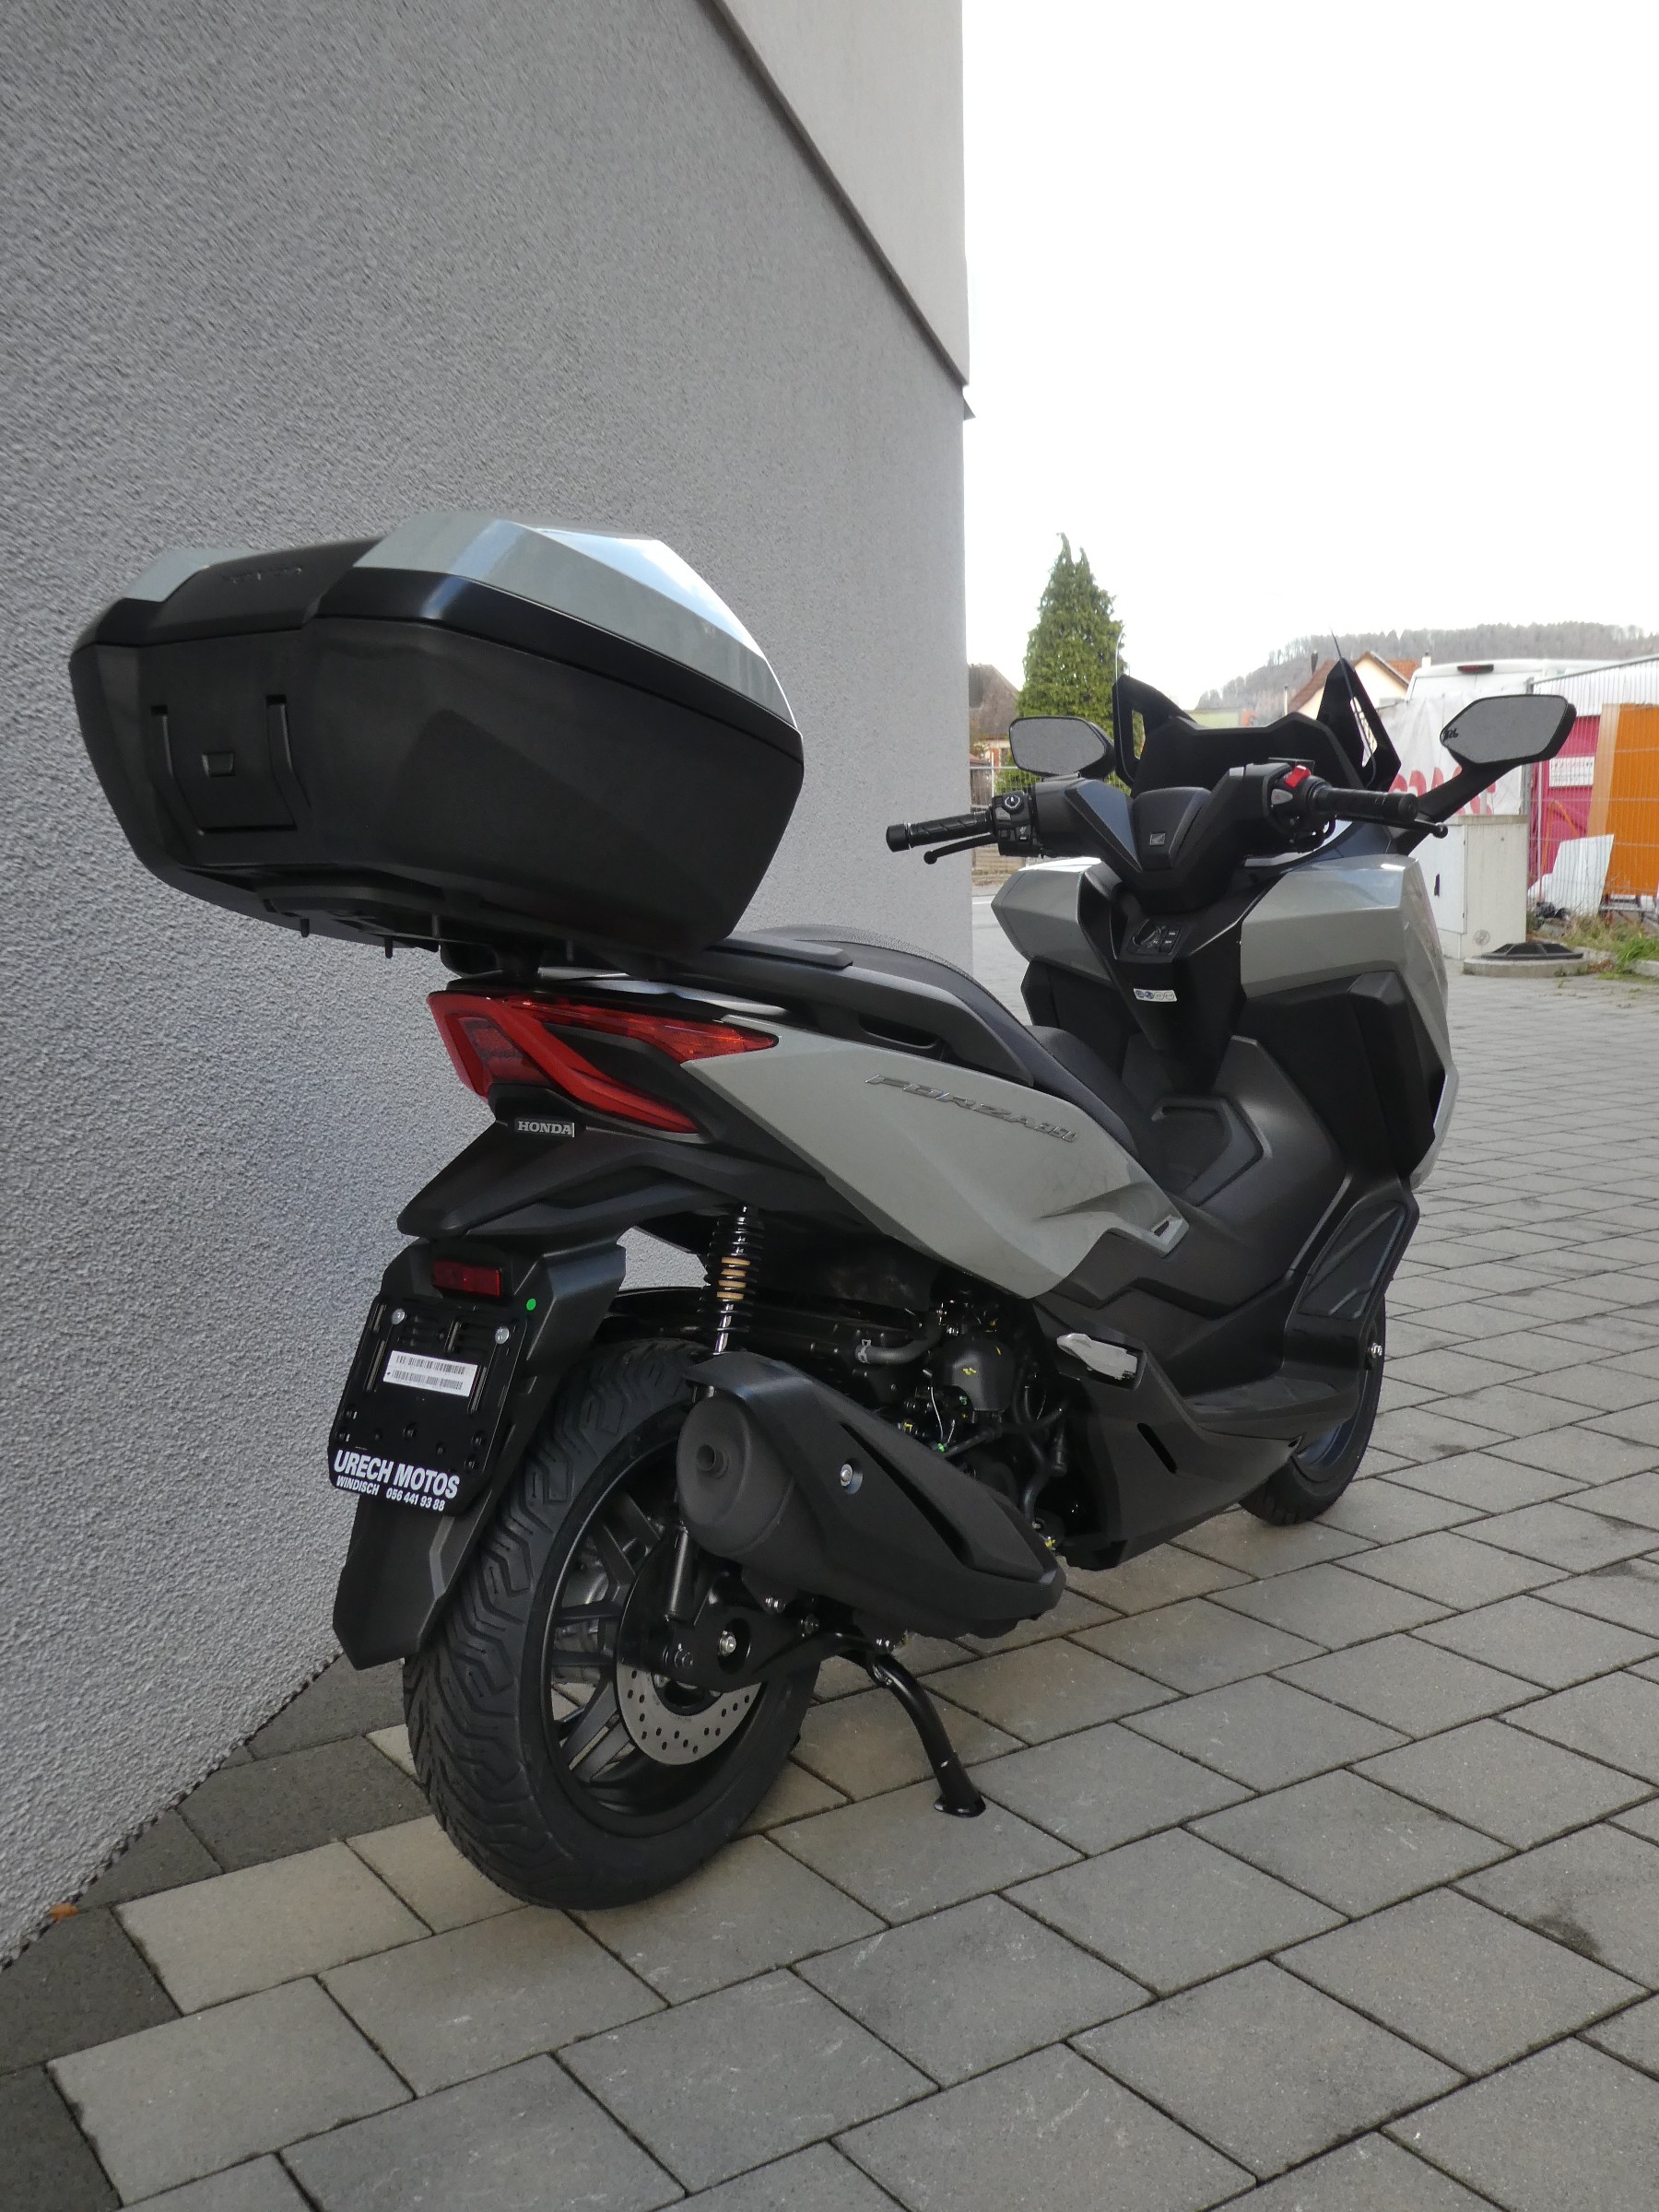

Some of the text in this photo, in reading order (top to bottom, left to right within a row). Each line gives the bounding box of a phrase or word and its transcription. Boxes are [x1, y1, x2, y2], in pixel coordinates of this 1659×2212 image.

[865, 1074, 1035, 1130] FORZA
[517, 1121, 572, 1135] HONDA
[334, 1449, 460, 1500] URECH MOTOS
[335, 1475, 445, 1512] WINDISCH 056 441 93 88
